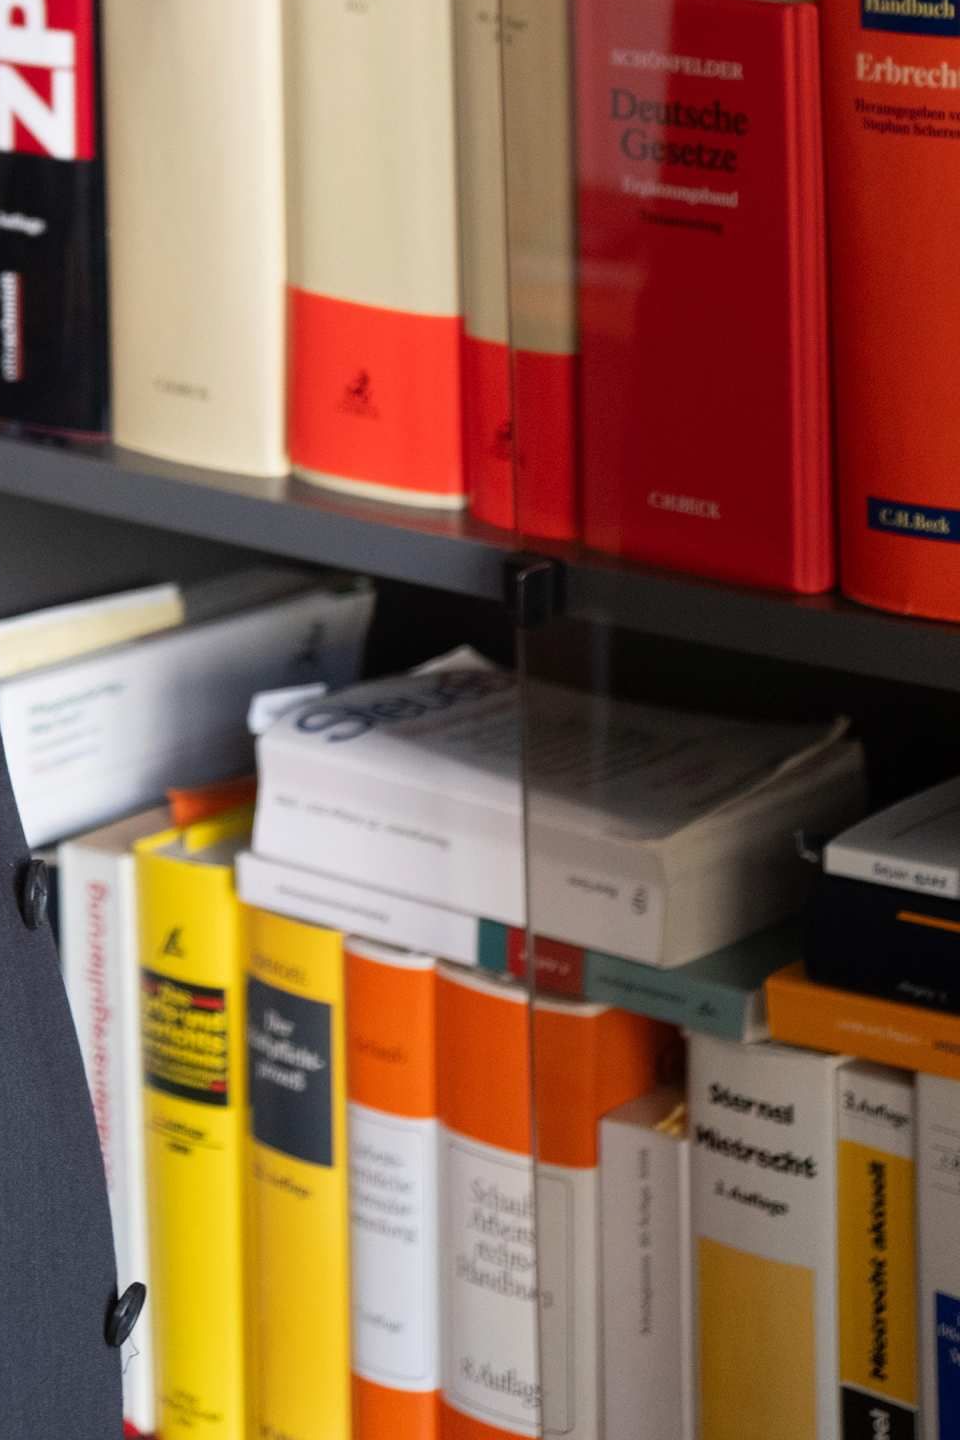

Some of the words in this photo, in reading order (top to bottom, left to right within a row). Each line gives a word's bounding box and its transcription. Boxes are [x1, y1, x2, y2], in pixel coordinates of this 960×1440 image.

[609, 88, 749, 136] Deutsche
[619, 128, 737, 173] Gesetze
[878, 507, 951, 535] C.H.Beck
[709, 1082, 795, 1126] Sternel
[695, 1123, 819, 1179] Mietrecht
